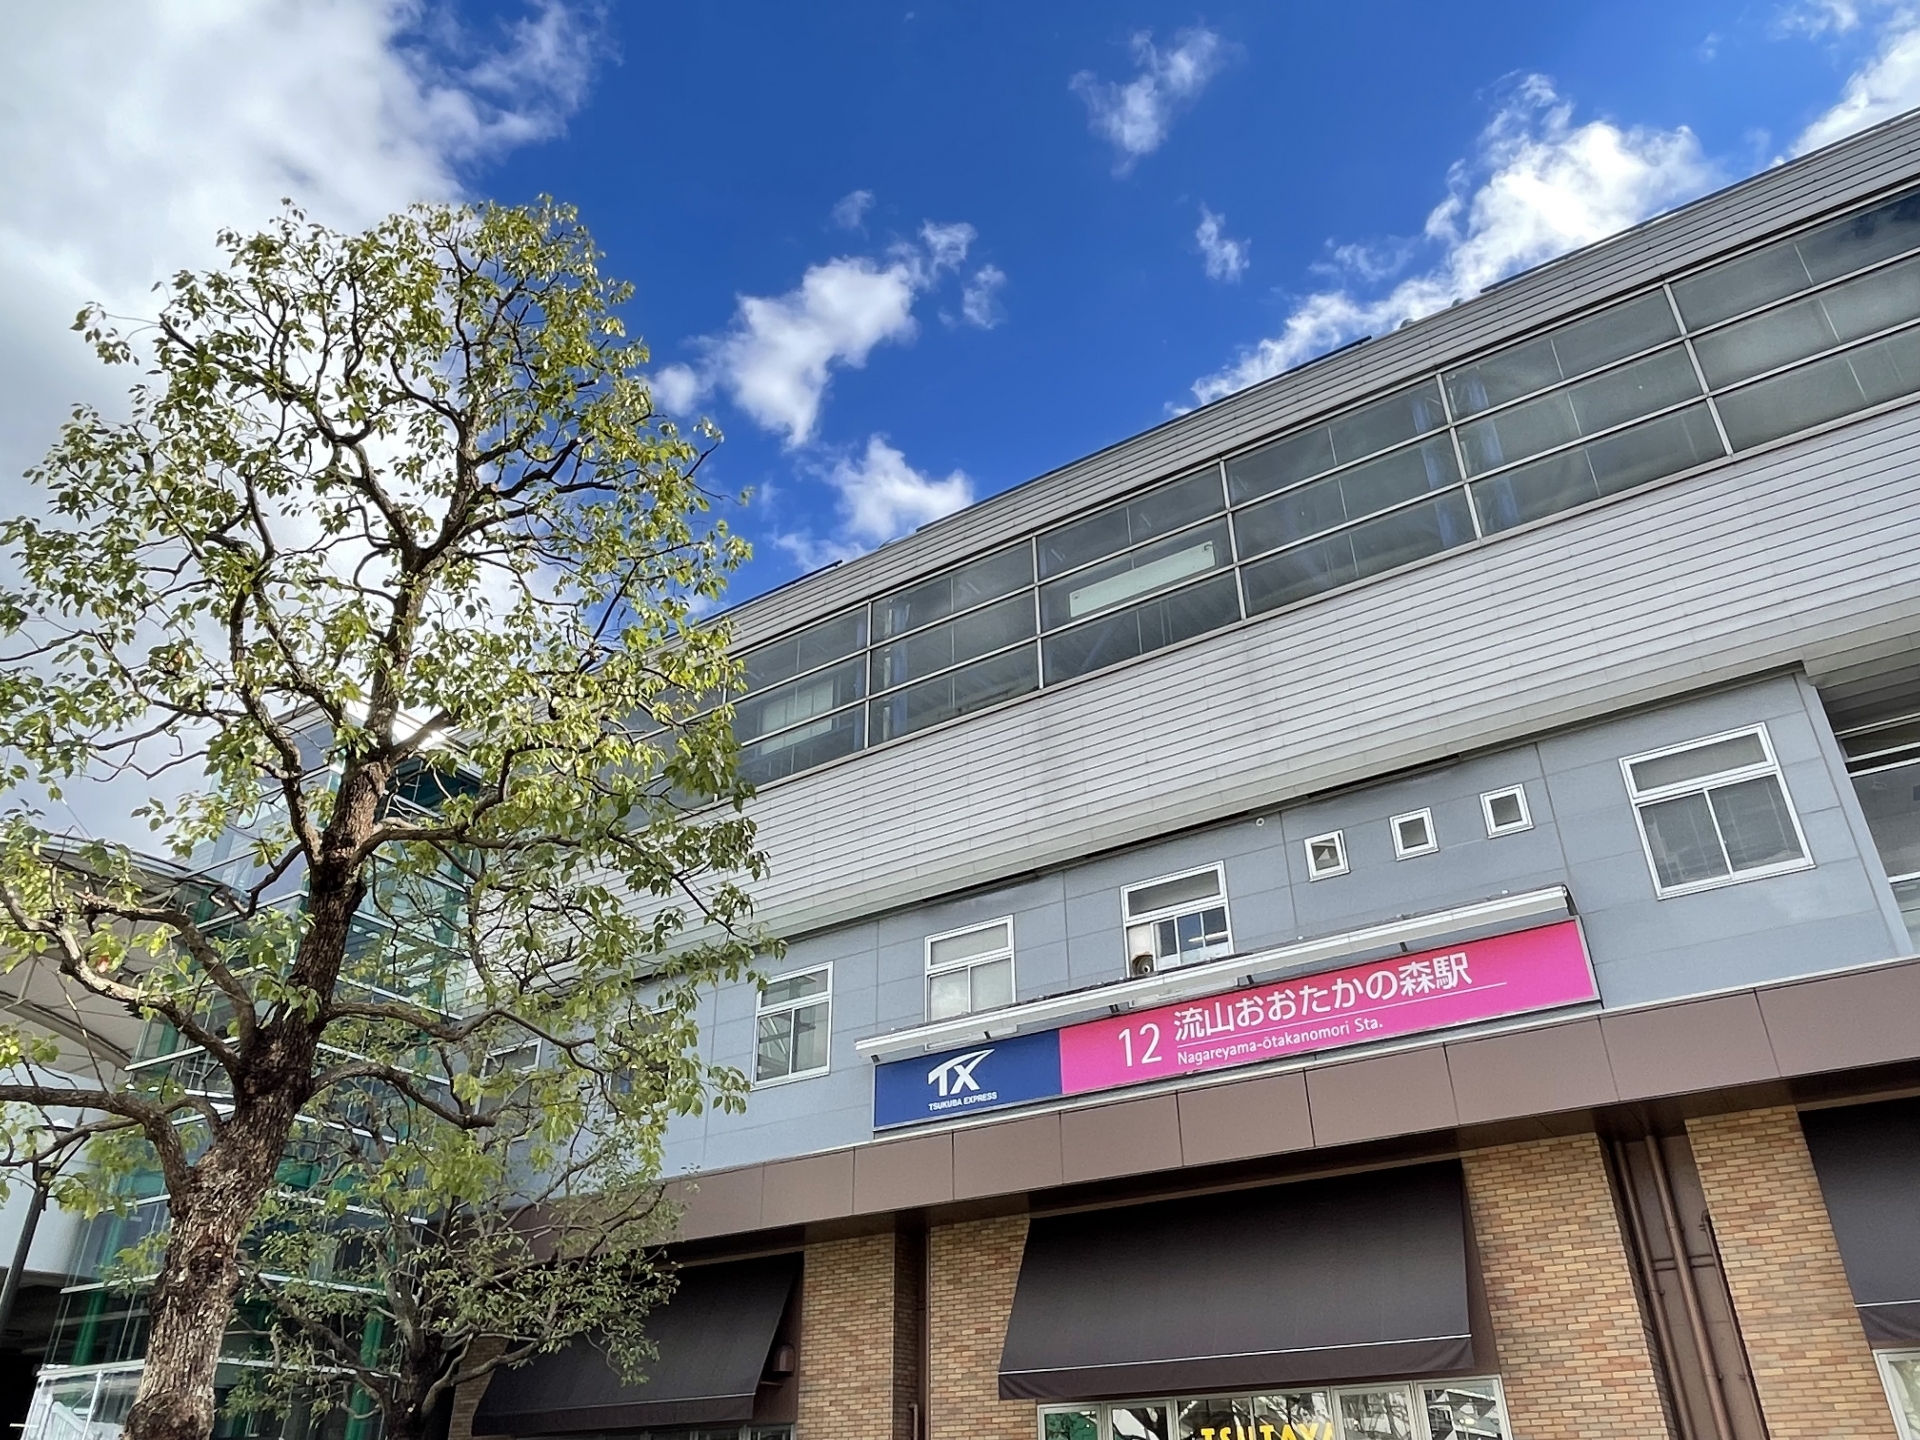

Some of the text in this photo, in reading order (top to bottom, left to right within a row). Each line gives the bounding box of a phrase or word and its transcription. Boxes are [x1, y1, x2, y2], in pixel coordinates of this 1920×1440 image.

[1118, 952, 1473, 1067] 12 流山おおたかの森駅
[1354, 1017, 1384, 1033] Sta.
[927, 1048, 996, 1097] TX
[928, 1091, 998, 1111] TSUKUBA EXPRESS
